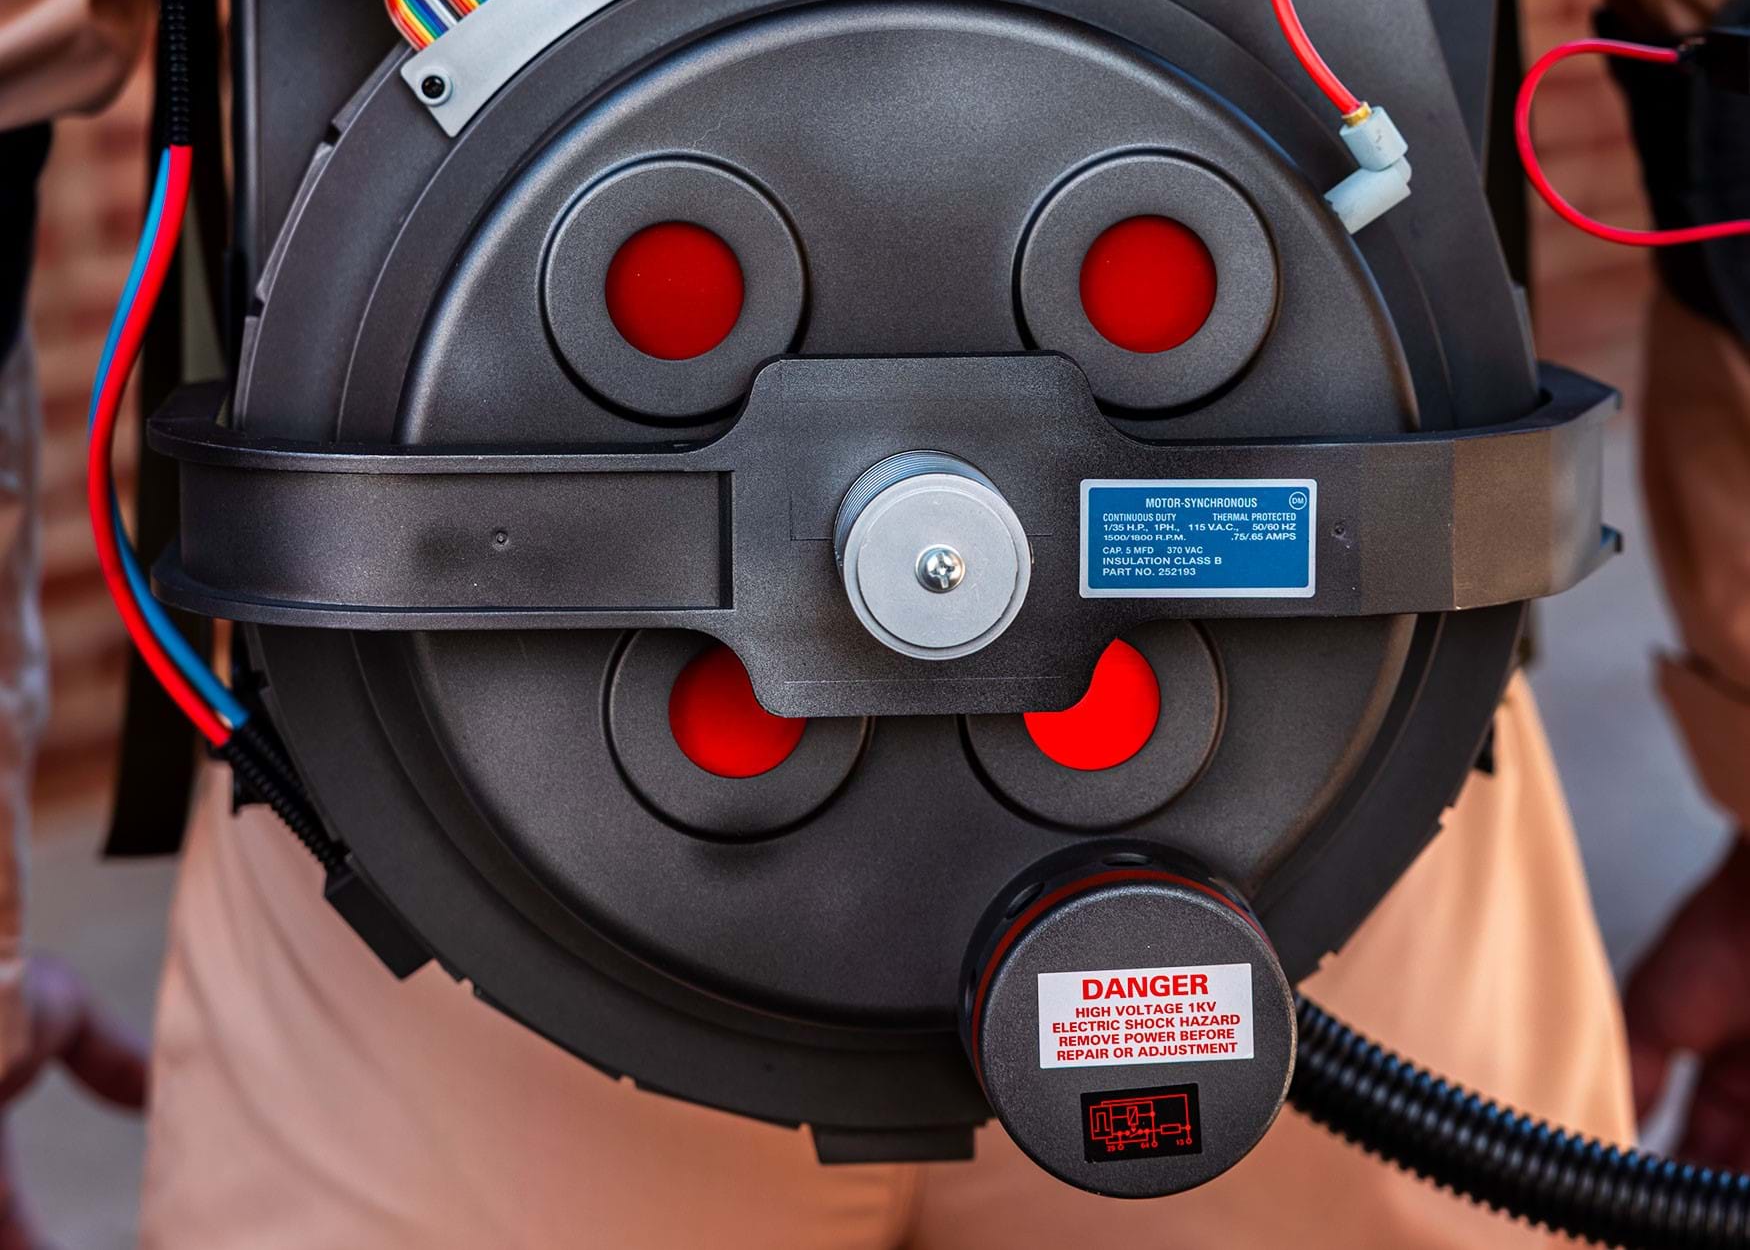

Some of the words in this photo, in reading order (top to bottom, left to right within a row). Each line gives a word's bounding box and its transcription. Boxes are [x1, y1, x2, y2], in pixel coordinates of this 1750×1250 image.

[1145, 497, 1258, 508] MOTOR-SYNCHRONOUS
[1103, 513, 1154, 522] CONTINUOUS
[1155, 513, 1176, 522] DUTY
[1213, 512, 1249, 521] THERMAL
[1251, 512, 1296, 521] PROTECTED
[1189, 523, 1206, 531] 115
[1252, 523, 1279, 531] 50/60
[1281, 523, 1296, 531] HZ
[1231, 533, 1263, 541] .75/.65
[1185, 546, 1203, 554] VAC
[1103, 557, 1170, 565] INSULATION
[1174, 557, 1211, 565] CLASS
[1214, 557, 1222, 565] B
[1102, 568, 1131, 576] PART
[1135, 568, 1155, 576] NO.
[1158, 568, 1196, 576] 252193
[1082, 974, 1209, 1000] DANGER
[1075, 1006, 1111, 1018] HIGH
[1115, 1003, 1183, 1016] VOLTAGE
[1189, 1001, 1217, 1013] 1KV
[1052, 1019, 1121, 1034] ELECTRIC
[1125, 1017, 1176, 1030] SHOCK
[1180, 1014, 1241, 1027] HAZARD
[1059, 1033, 1120, 1047] REMOVE
[1124, 1031, 1176, 1044] POWER
[1180, 1028, 1235, 1041] BEFORE
[1057, 1047, 1109, 1061] REPAIR
[1113, 1046, 1134, 1058] OR
[1138, 1042, 1238, 1057] ADJUSTMENT
